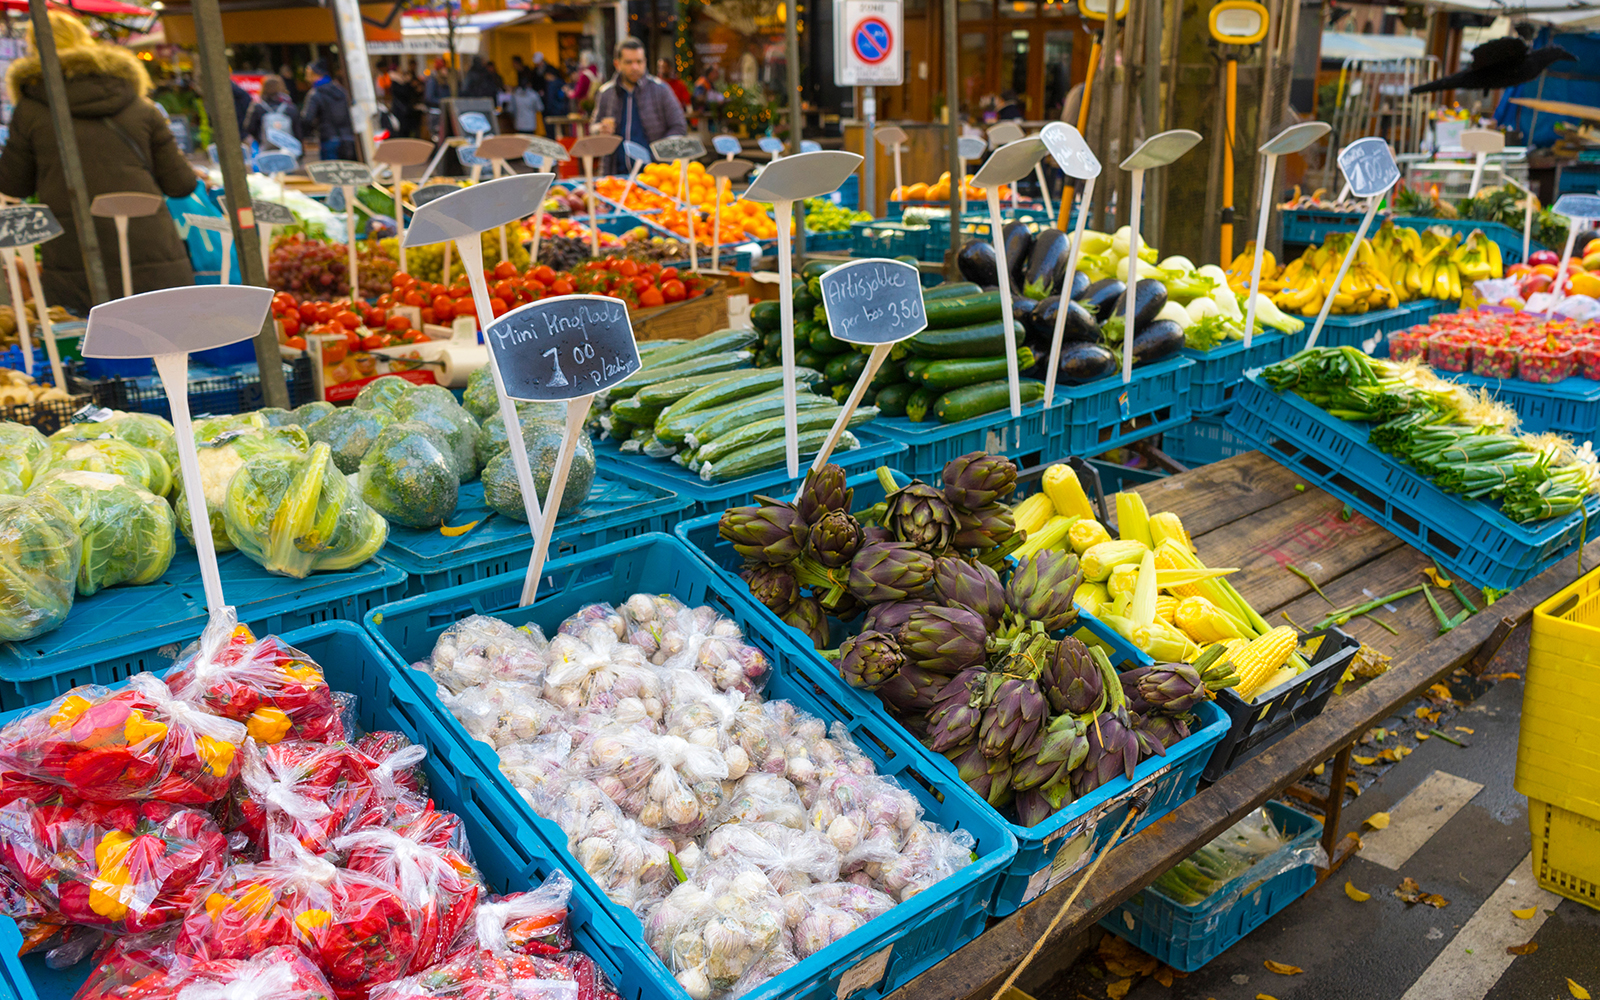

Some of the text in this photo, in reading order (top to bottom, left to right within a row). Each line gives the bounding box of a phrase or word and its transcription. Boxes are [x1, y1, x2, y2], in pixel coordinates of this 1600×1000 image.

[860, 4, 885, 12] ZONE
[841, 299, 920, 336] per bos 3,50
[494, 322, 538, 350] Mini
